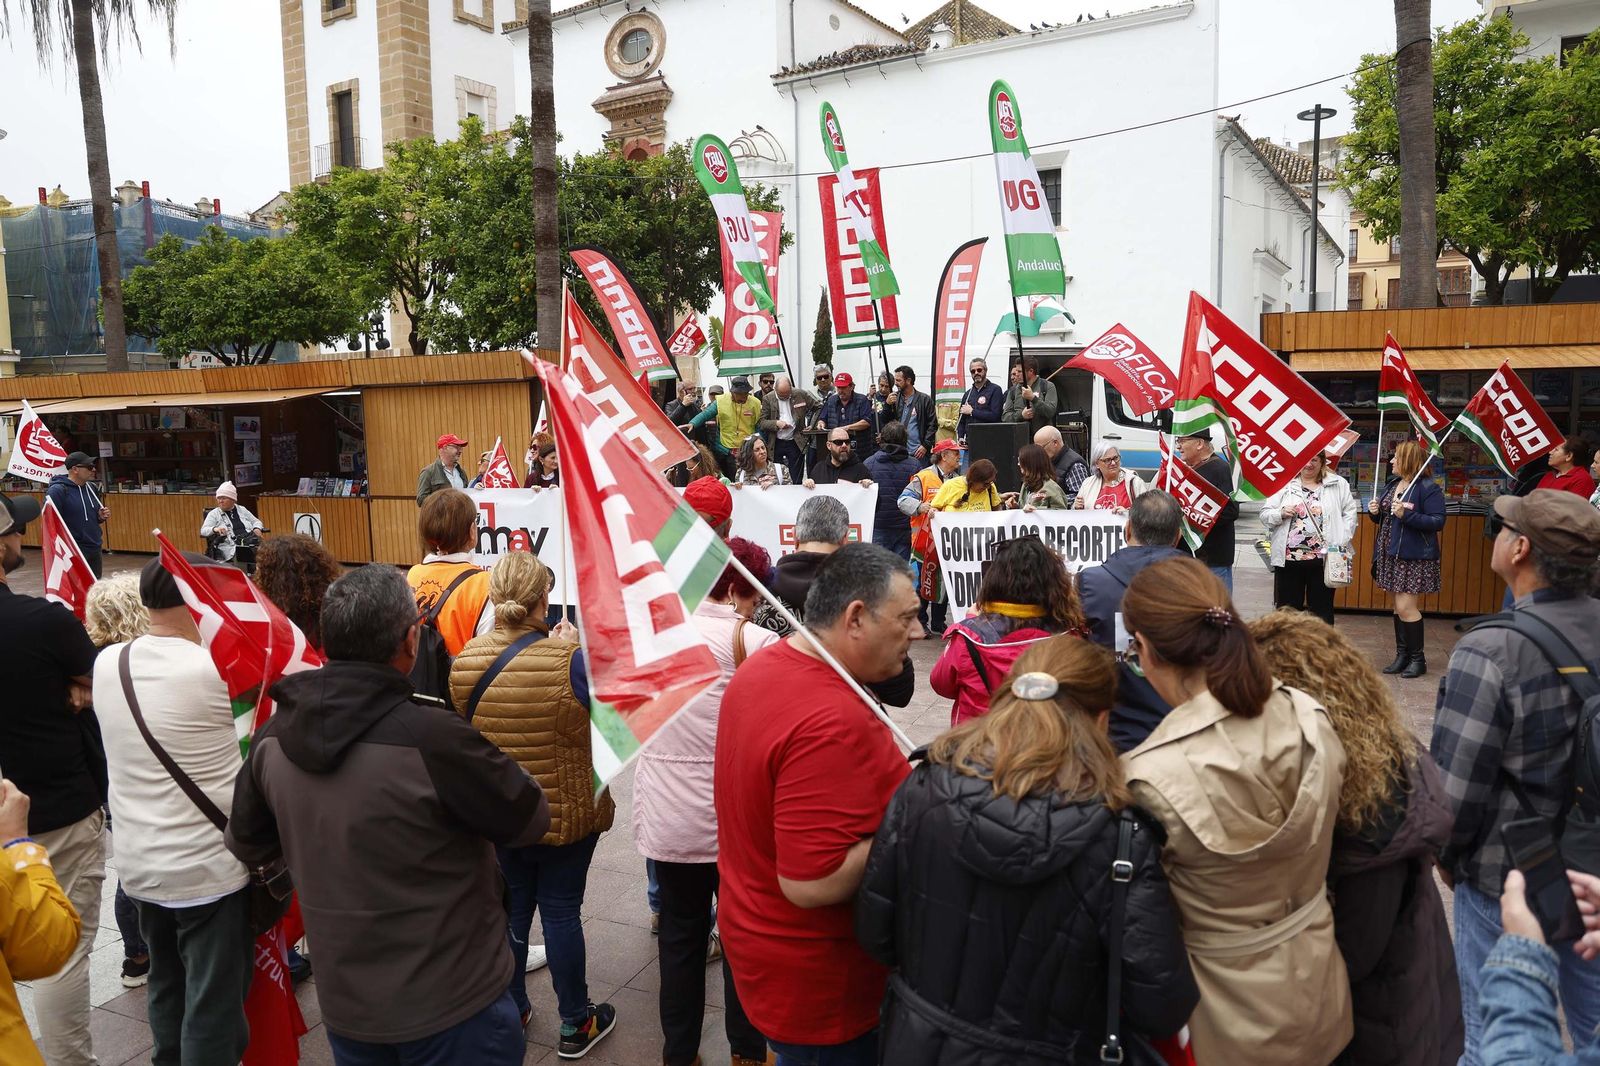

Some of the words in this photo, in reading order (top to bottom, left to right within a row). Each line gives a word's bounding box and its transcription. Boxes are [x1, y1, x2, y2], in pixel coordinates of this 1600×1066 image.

[1003, 179, 1041, 212] UG
[945, 264, 973, 376] CCOO
[1123, 353, 1175, 405] FICA
[1197, 315, 1324, 458] COO
[1483, 370, 1551, 456] CCOO
[1500, 428, 1521, 466] Cádiz
[12, 463, 54, 478] w.UGT.es
[1045, 525, 1125, 562] RECORTE
